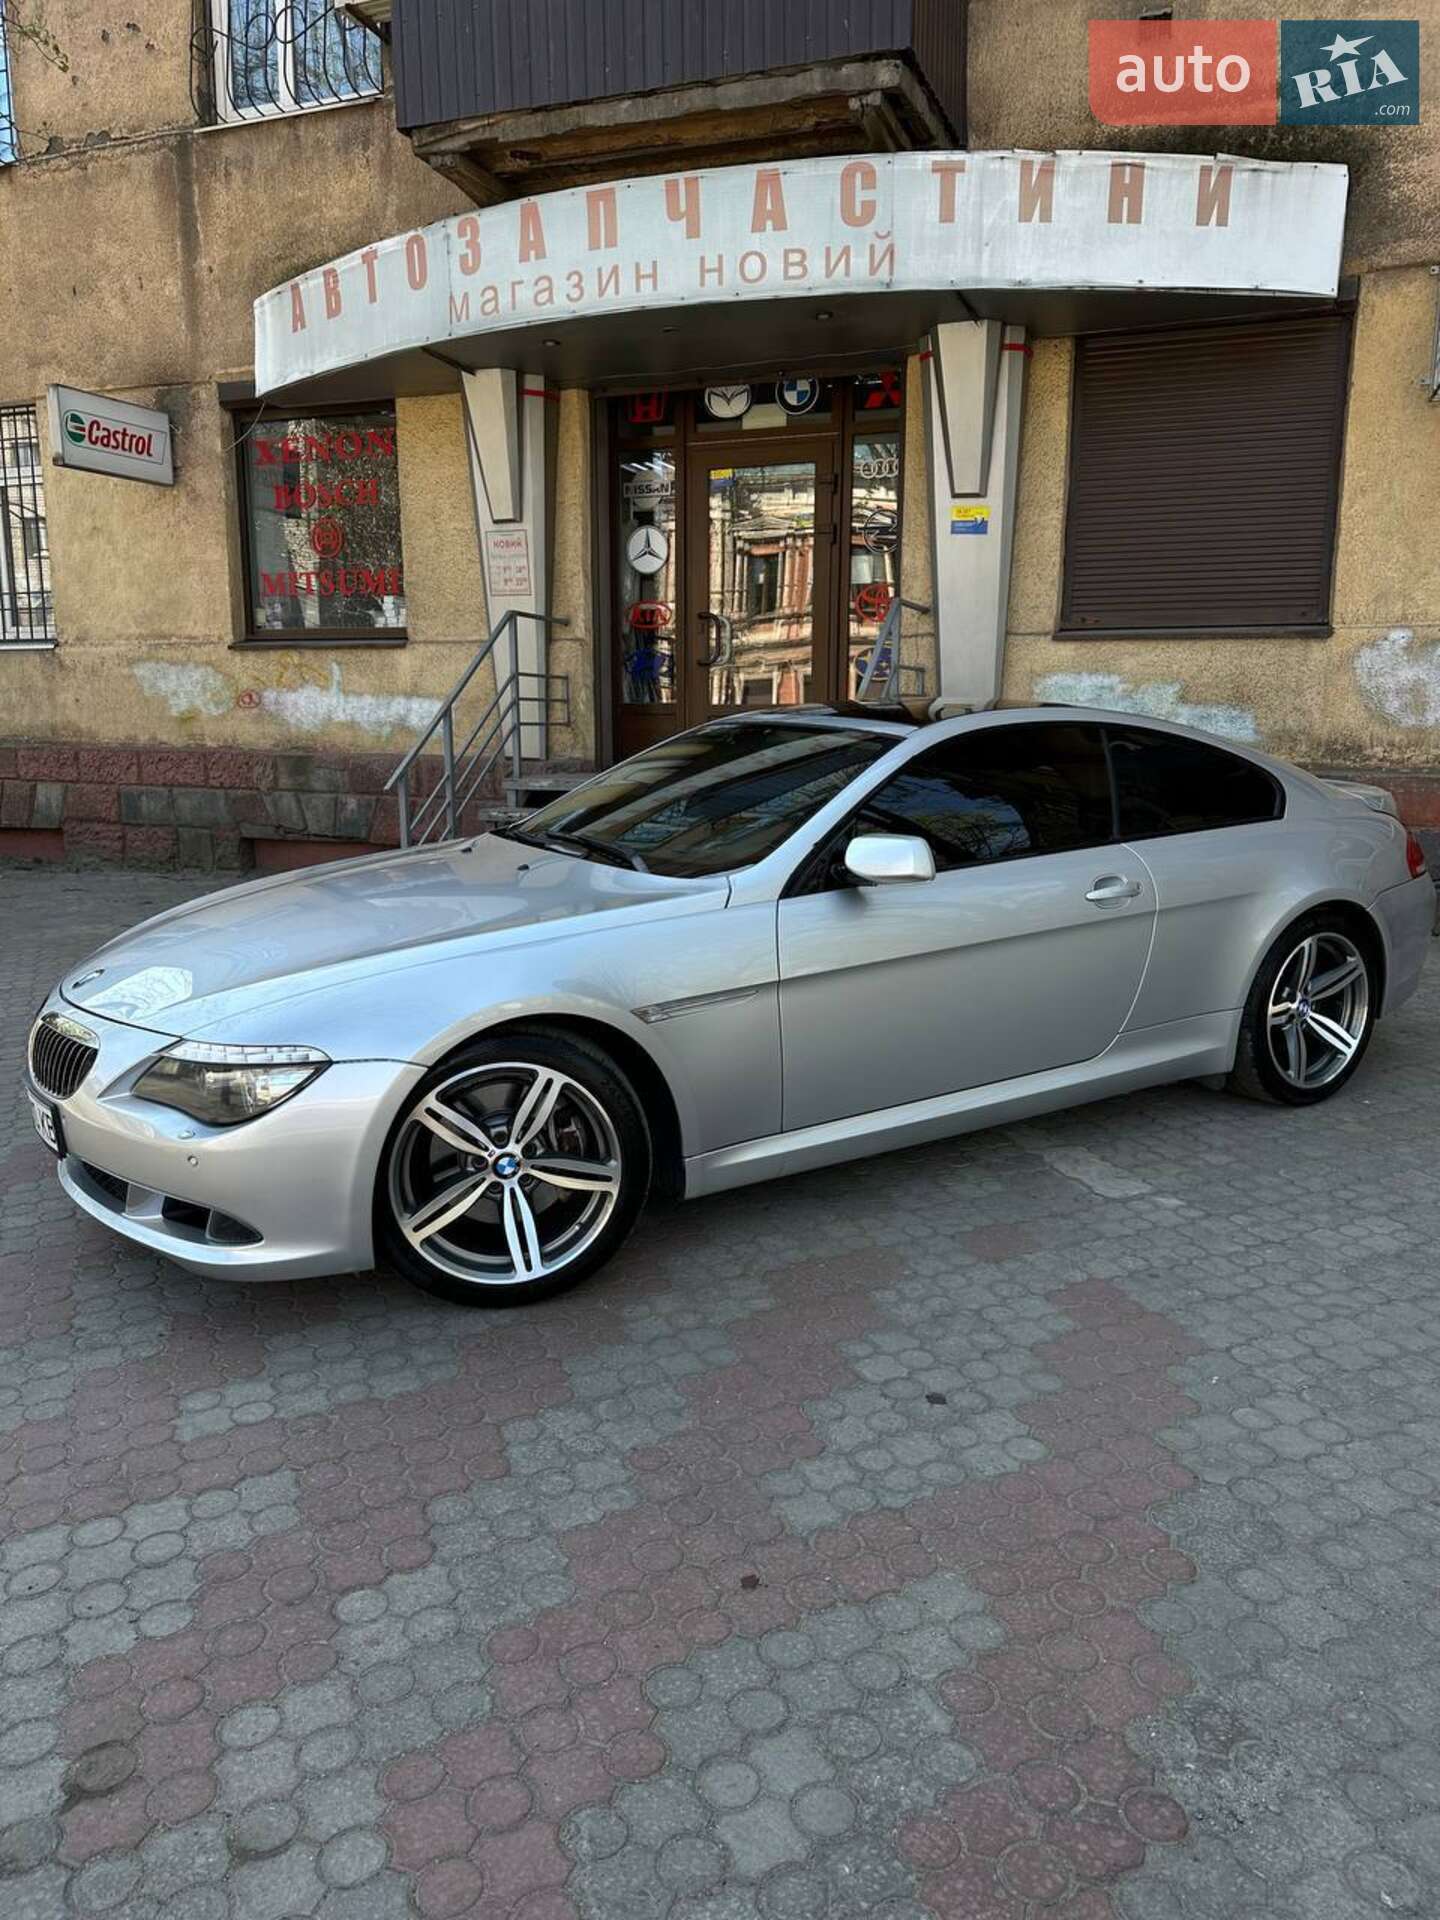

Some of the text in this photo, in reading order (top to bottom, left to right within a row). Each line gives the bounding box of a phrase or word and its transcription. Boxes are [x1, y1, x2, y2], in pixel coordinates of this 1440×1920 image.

[289, 159, 1234, 334] АВТОЗАПЧАСТИНИ
[450, 259, 658, 324] магазин
[87, 419, 153, 458] Castrol
[254, 428, 395, 466] XENON
[272, 478, 380, 511] BOSCH
[260, 567, 401, 598] MITSUMI
